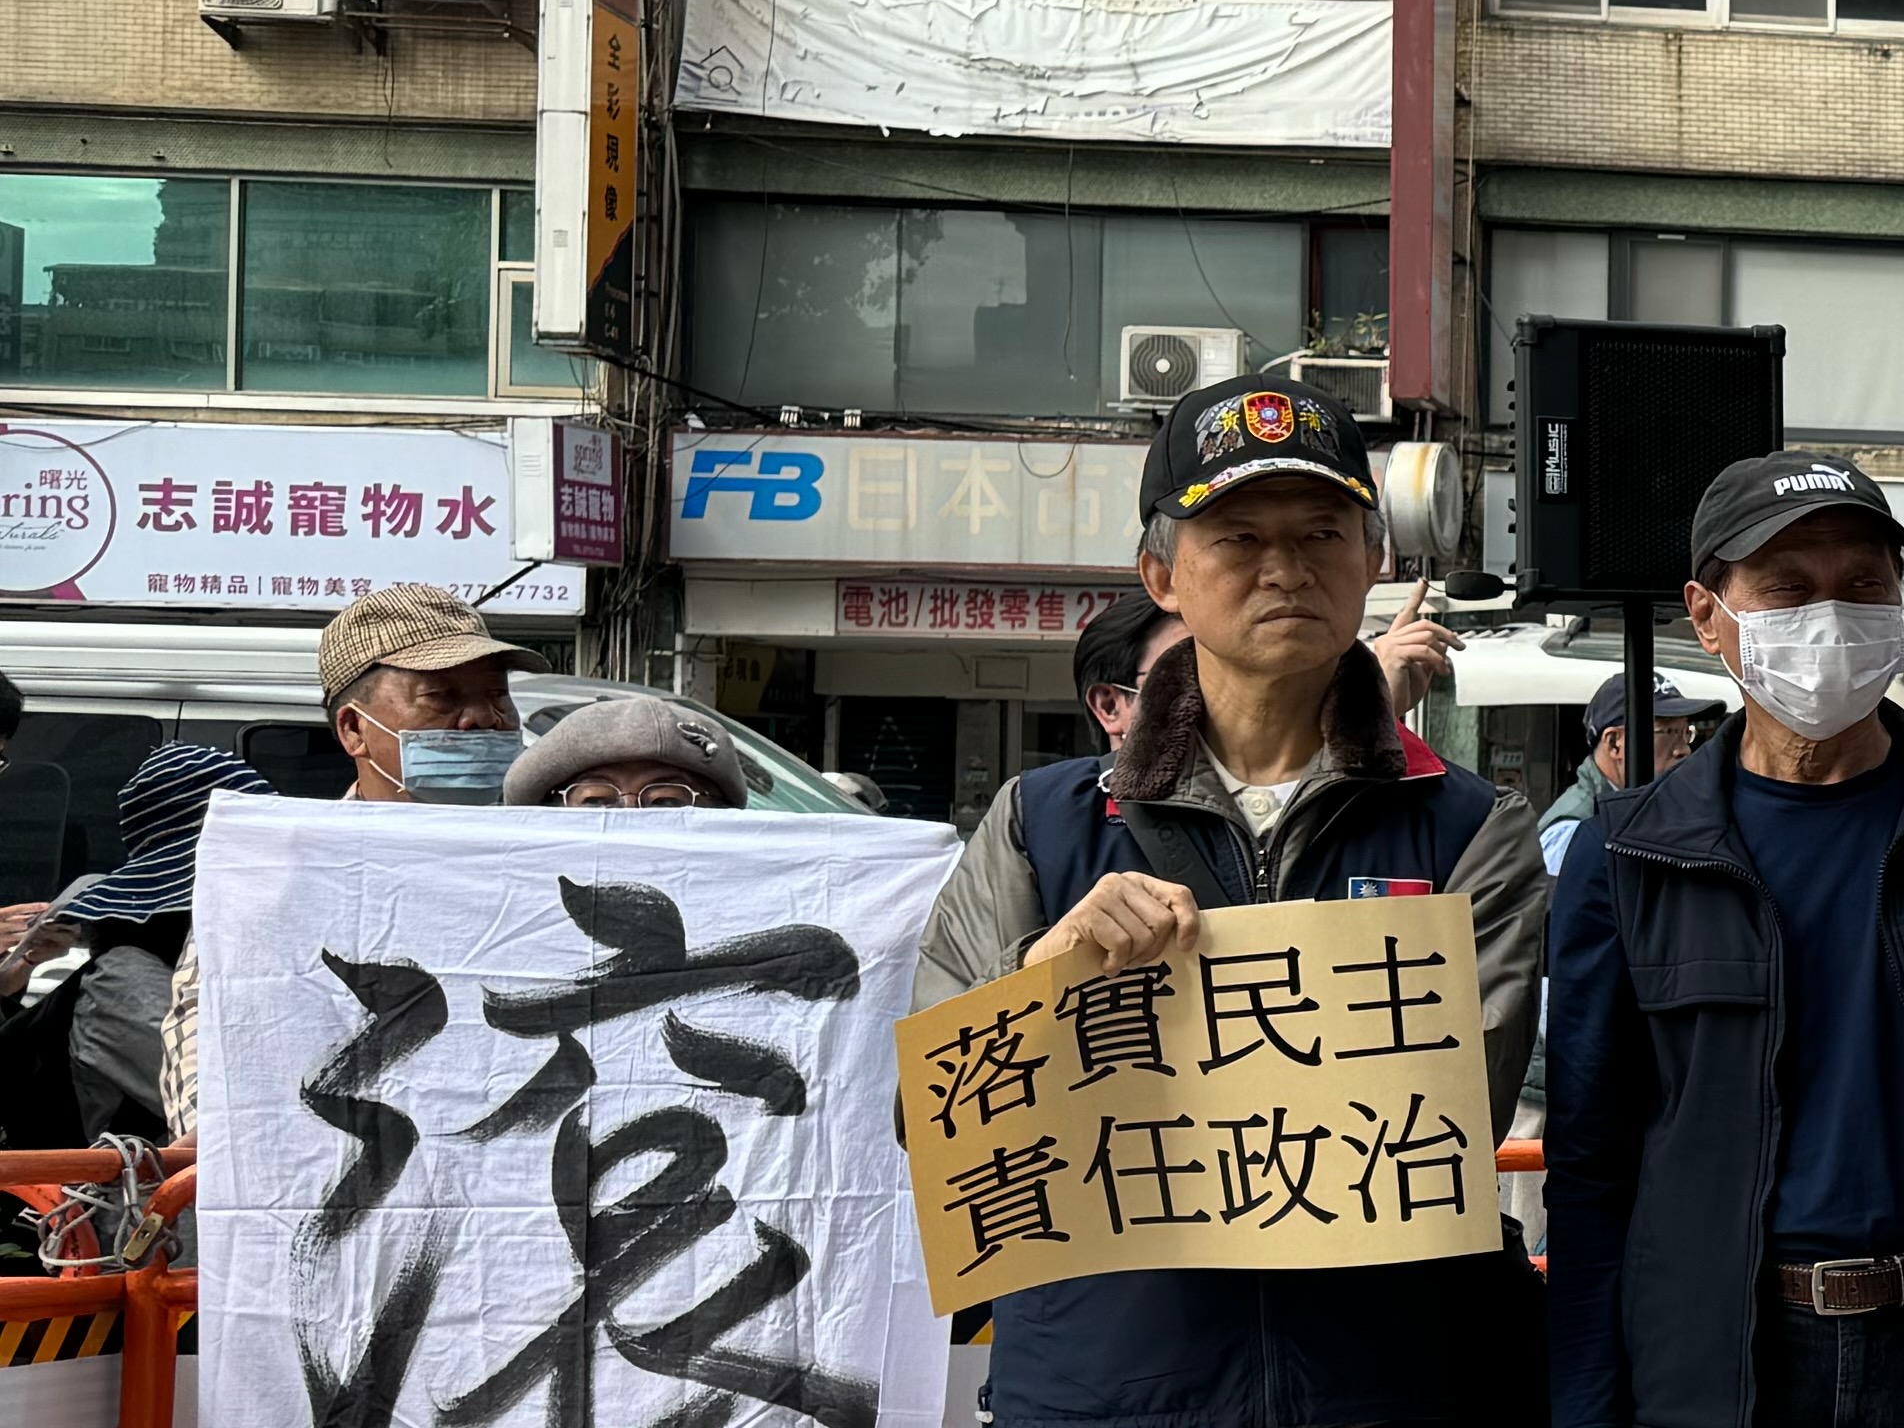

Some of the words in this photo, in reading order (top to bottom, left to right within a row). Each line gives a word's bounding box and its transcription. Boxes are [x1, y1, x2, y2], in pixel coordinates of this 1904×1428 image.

[39, 469, 88, 491] 曙光
[680, 449, 825, 522] FB
[847, 444, 1145, 538] 日本古
[1773, 472, 1848, 497] PUMA
[136, 477, 497, 540] 志誠寵物水
[147, 573, 249, 596] 寵物精品
[841, 585, 1066, 631] 電池/批發零售
[1075, 590, 1129, 630] 27
[924, 935, 1461, 1139] 落實民主
[943, 1092, 1469, 1277] 責任政治
